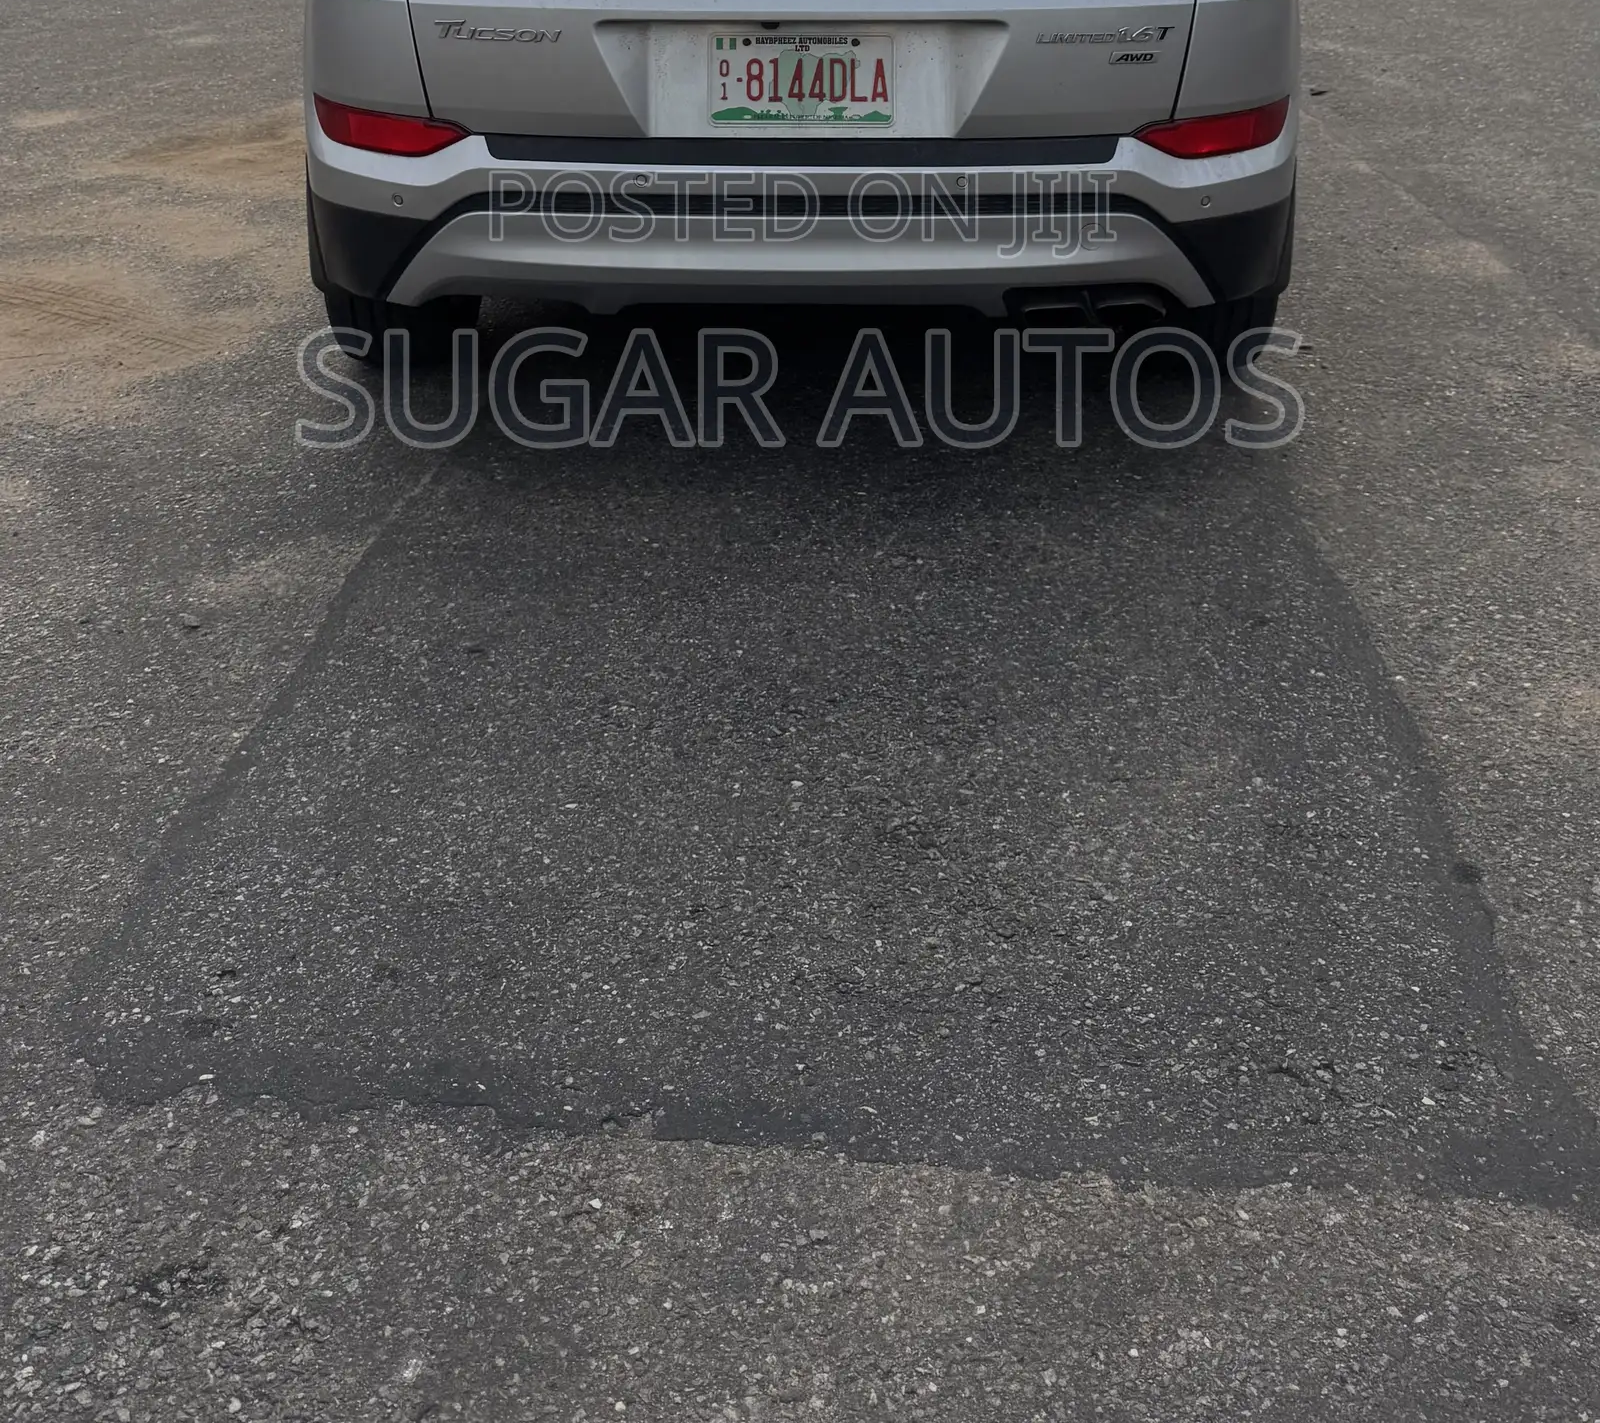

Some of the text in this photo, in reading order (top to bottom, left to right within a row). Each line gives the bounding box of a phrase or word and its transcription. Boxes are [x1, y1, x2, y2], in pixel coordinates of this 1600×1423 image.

[798, 37, 848, 45] AUTOMOBILES
[1036, 32, 1116, 44] LIMITED
[1115, 53, 1154, 62] AWD
